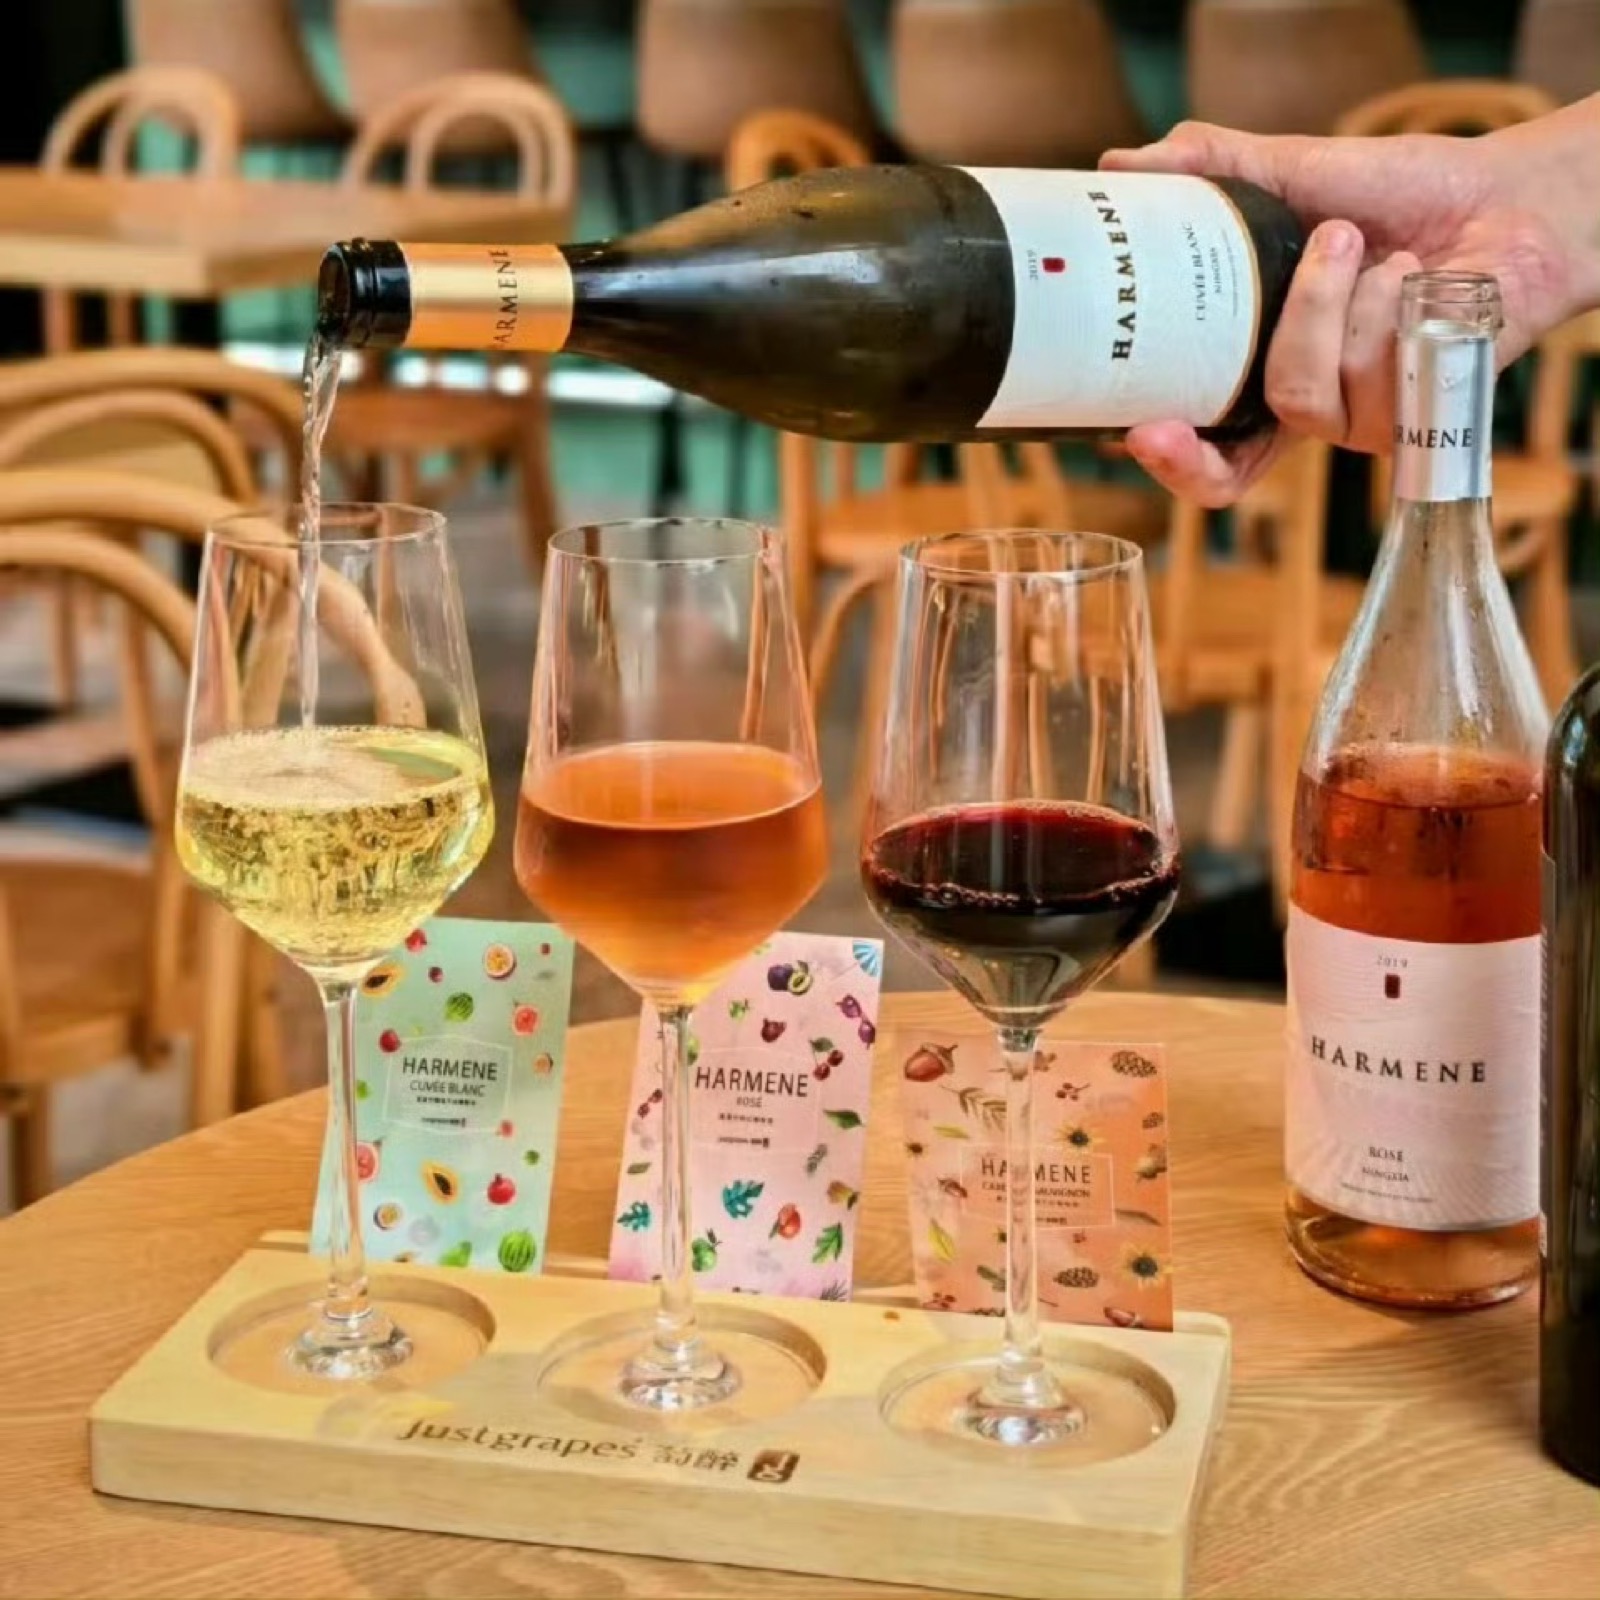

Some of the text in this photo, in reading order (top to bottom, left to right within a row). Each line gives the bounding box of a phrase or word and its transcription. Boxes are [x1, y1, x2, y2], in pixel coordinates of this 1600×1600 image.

[1181, 221, 1204, 268] BLANC
[1088, 191, 1136, 360] HARMENE
[488, 249, 518, 348] ARMENE
[1376, 954, 1408, 968] 2019
[402, 1057, 498, 1081] HARMENE
[1311, 1035, 1487, 1083] HARMENE
[447, 1082, 486, 1097] BLANC
[694, 1066, 809, 1097] HARMENE
[981, 1157, 1091, 1184] HAMENE
